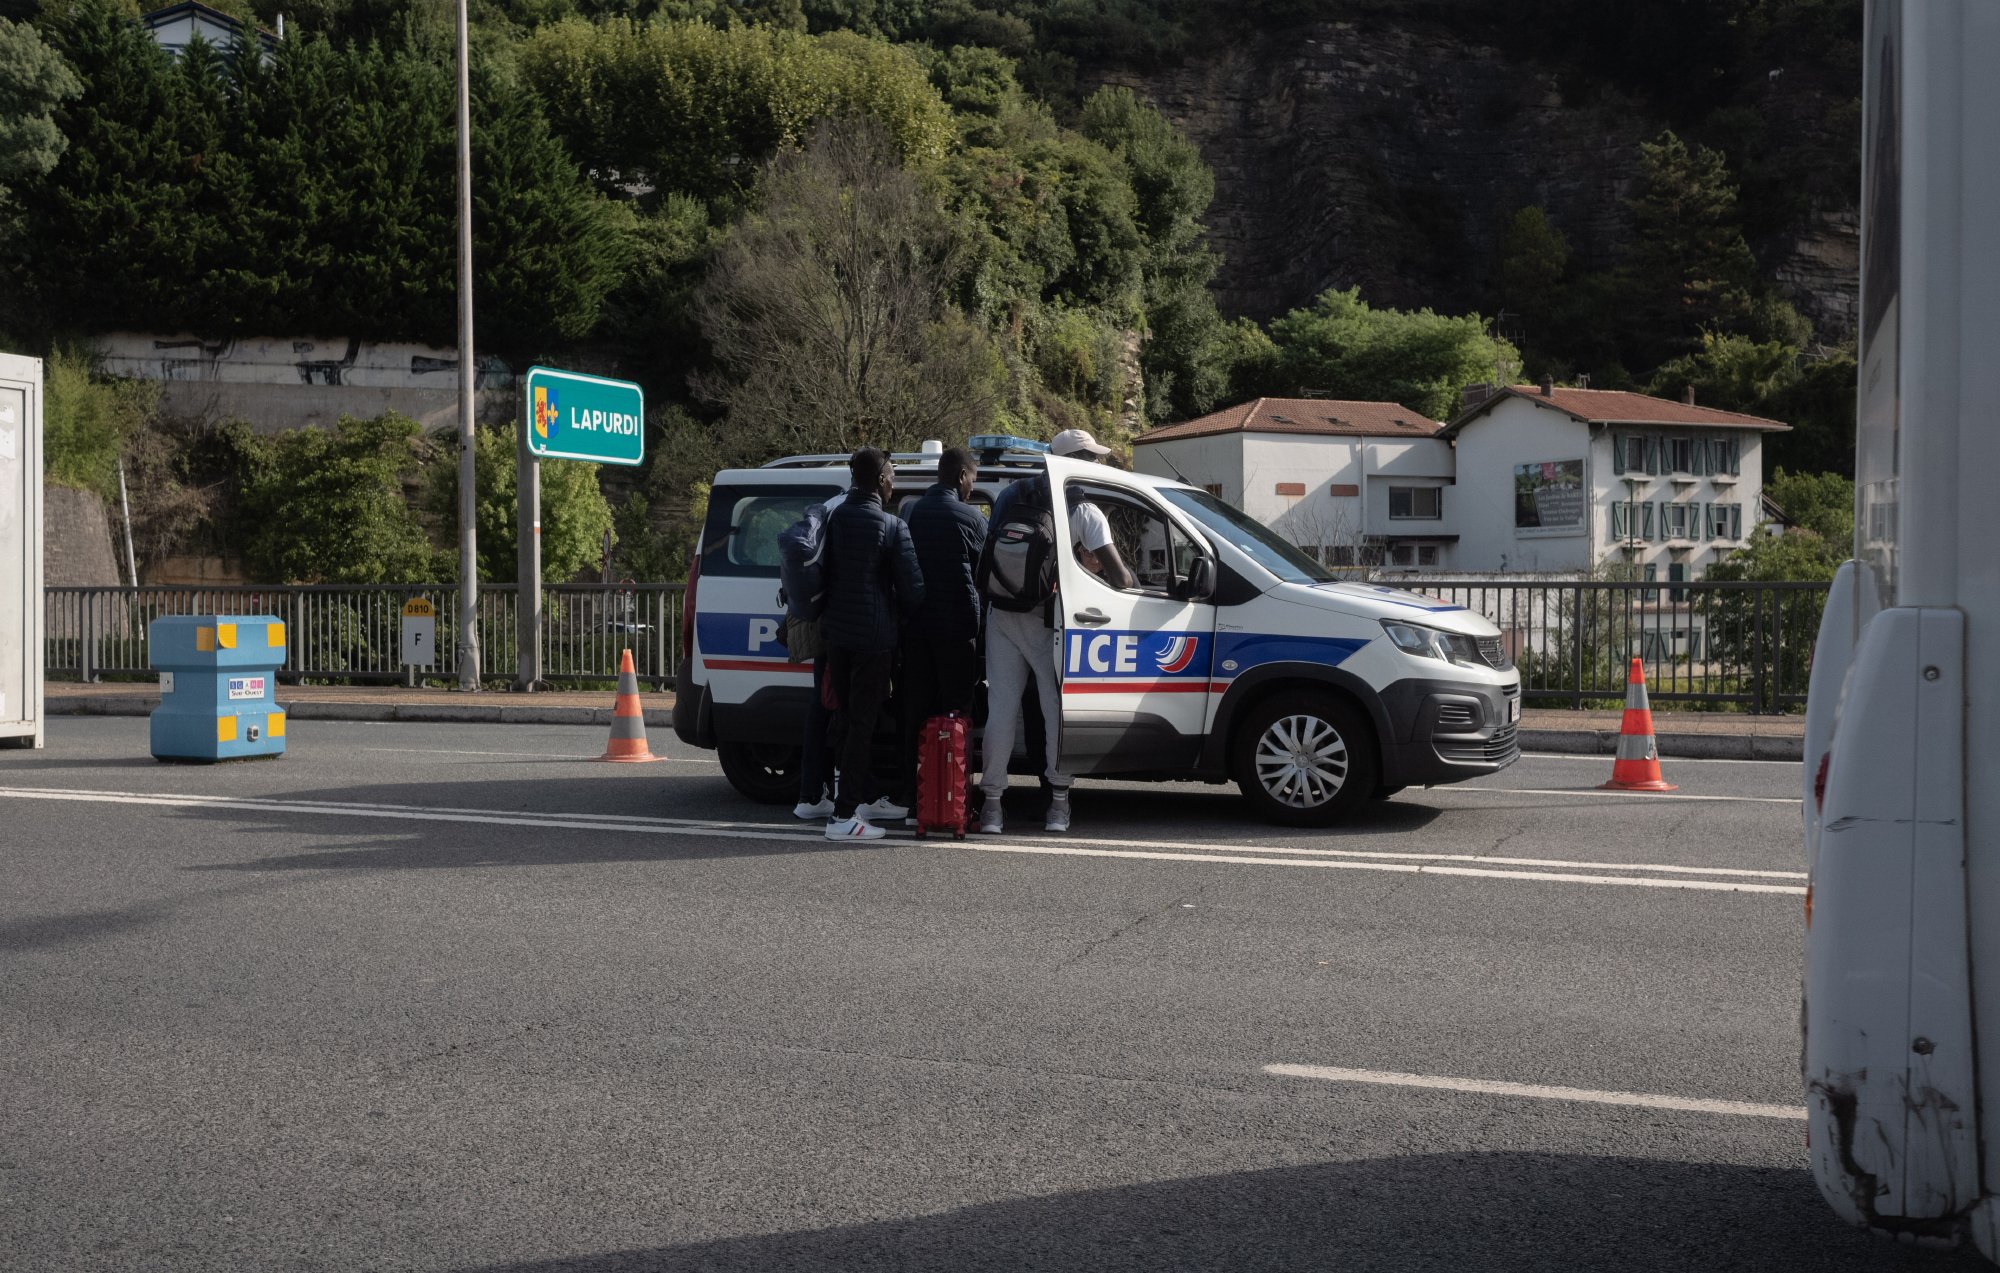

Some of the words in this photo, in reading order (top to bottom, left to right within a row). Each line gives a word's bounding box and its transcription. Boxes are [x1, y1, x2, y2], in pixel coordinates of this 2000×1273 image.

[571, 407, 638, 436] LAPURDI
[408, 605, 429, 613] D810
[414, 633, 422, 646] F
